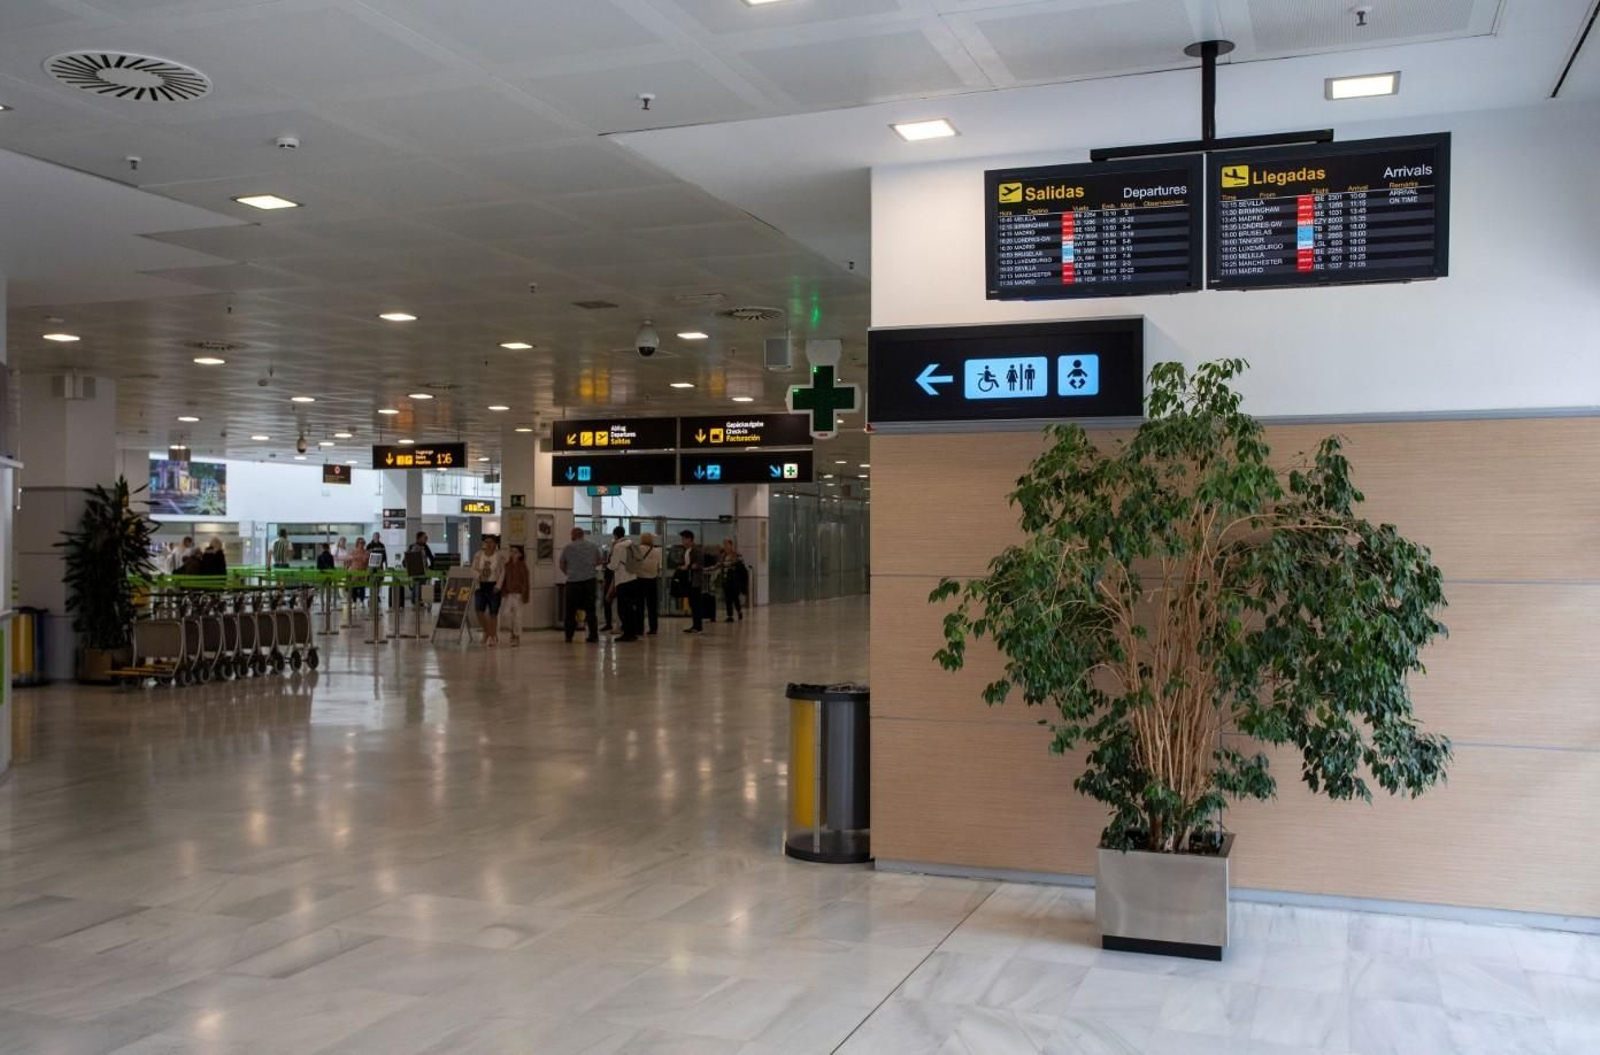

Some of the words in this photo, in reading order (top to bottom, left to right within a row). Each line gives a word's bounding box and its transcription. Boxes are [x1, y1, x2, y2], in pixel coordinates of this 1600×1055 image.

[1252, 167, 1326, 187] Llegadas
[1383, 163, 1434, 179] Arrivals
[1025, 184, 1085, 201] Salidas
[1123, 185, 1187, 200] Departures
[1348, 185, 1369, 193] Arrival
[1389, 188, 1418, 196] ARRIVAL
[1238, 206, 1280, 214] BIRMINGHAM
[1401, 195, 1418, 203] TIME
[1014, 229, 1035, 237] MADRID
[1238, 229, 1272, 237] BRUSELAS
[1238, 243, 1284, 252] LUXEMBURGO
[1238, 258, 1283, 267] MANCHESTER
[1014, 271, 1051, 279] MANCHESTER
[726, 434, 760, 442] Facturación
